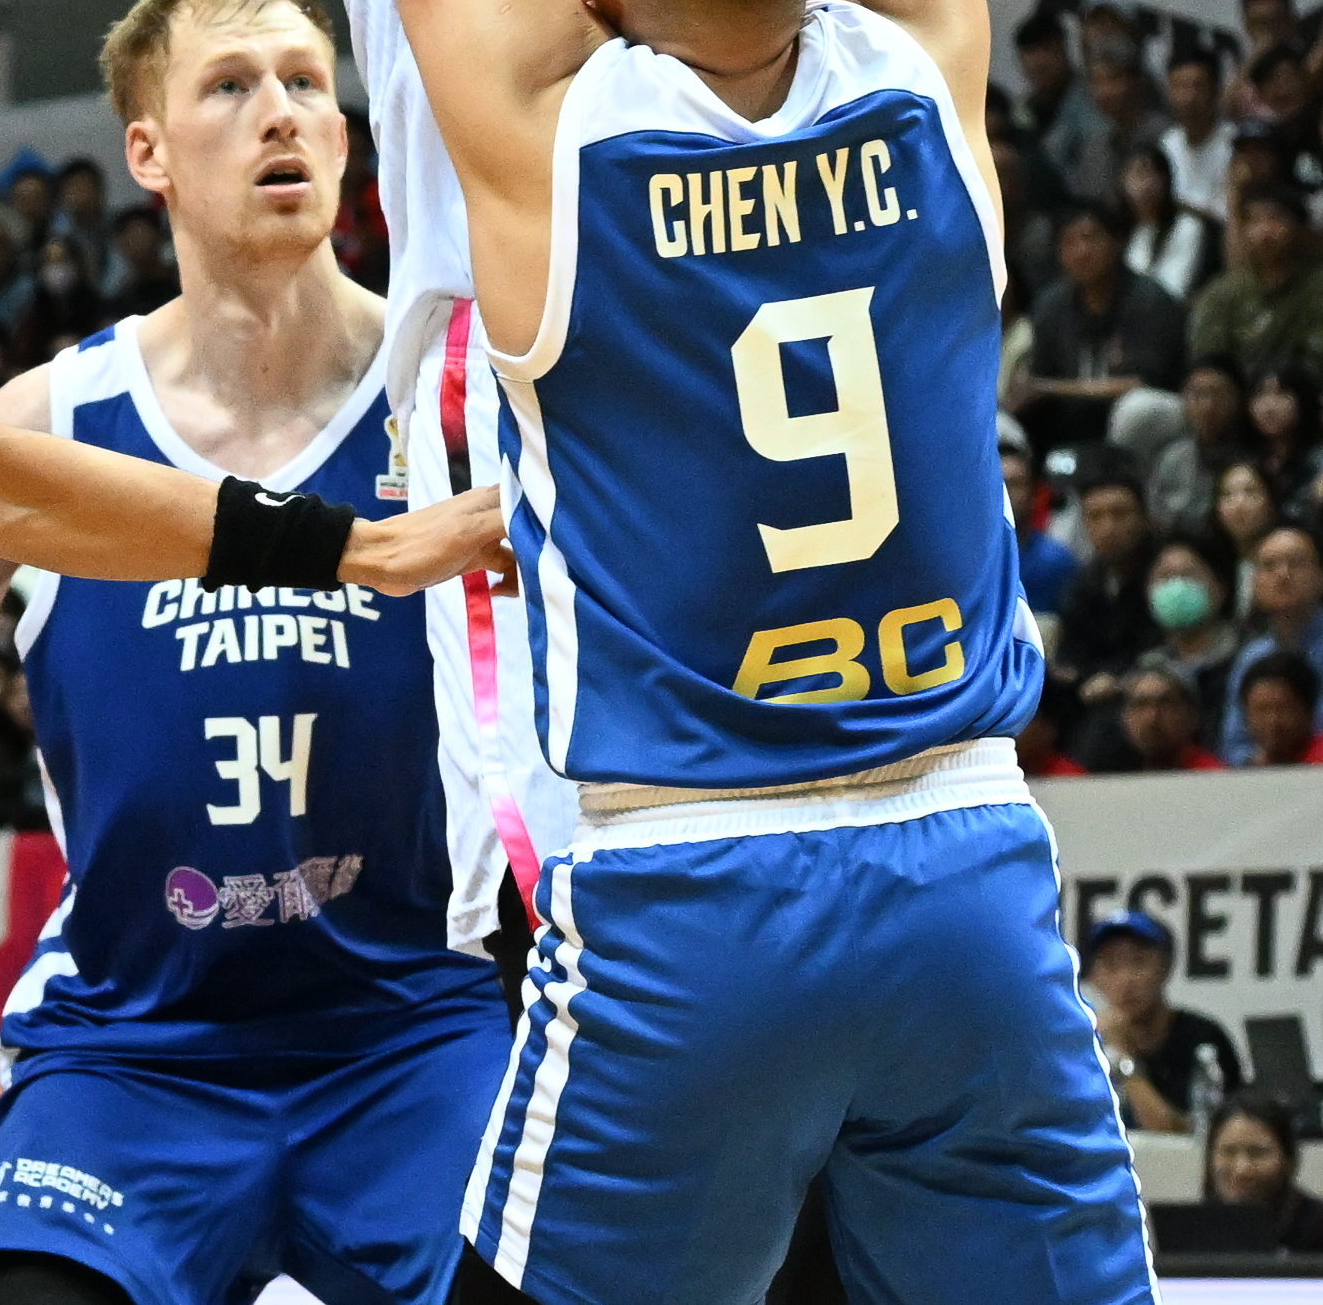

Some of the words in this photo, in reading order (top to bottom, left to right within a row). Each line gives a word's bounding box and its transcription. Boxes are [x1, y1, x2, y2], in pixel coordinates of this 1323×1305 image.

[648, 160, 802, 259] CHEN
[815, 138, 919, 236] Y.C.
[730, 285, 901, 575] 9
[175, 614, 351, 672] TAIPEI
[732, 597, 965, 705] BC
[204, 713, 318, 825] 34
